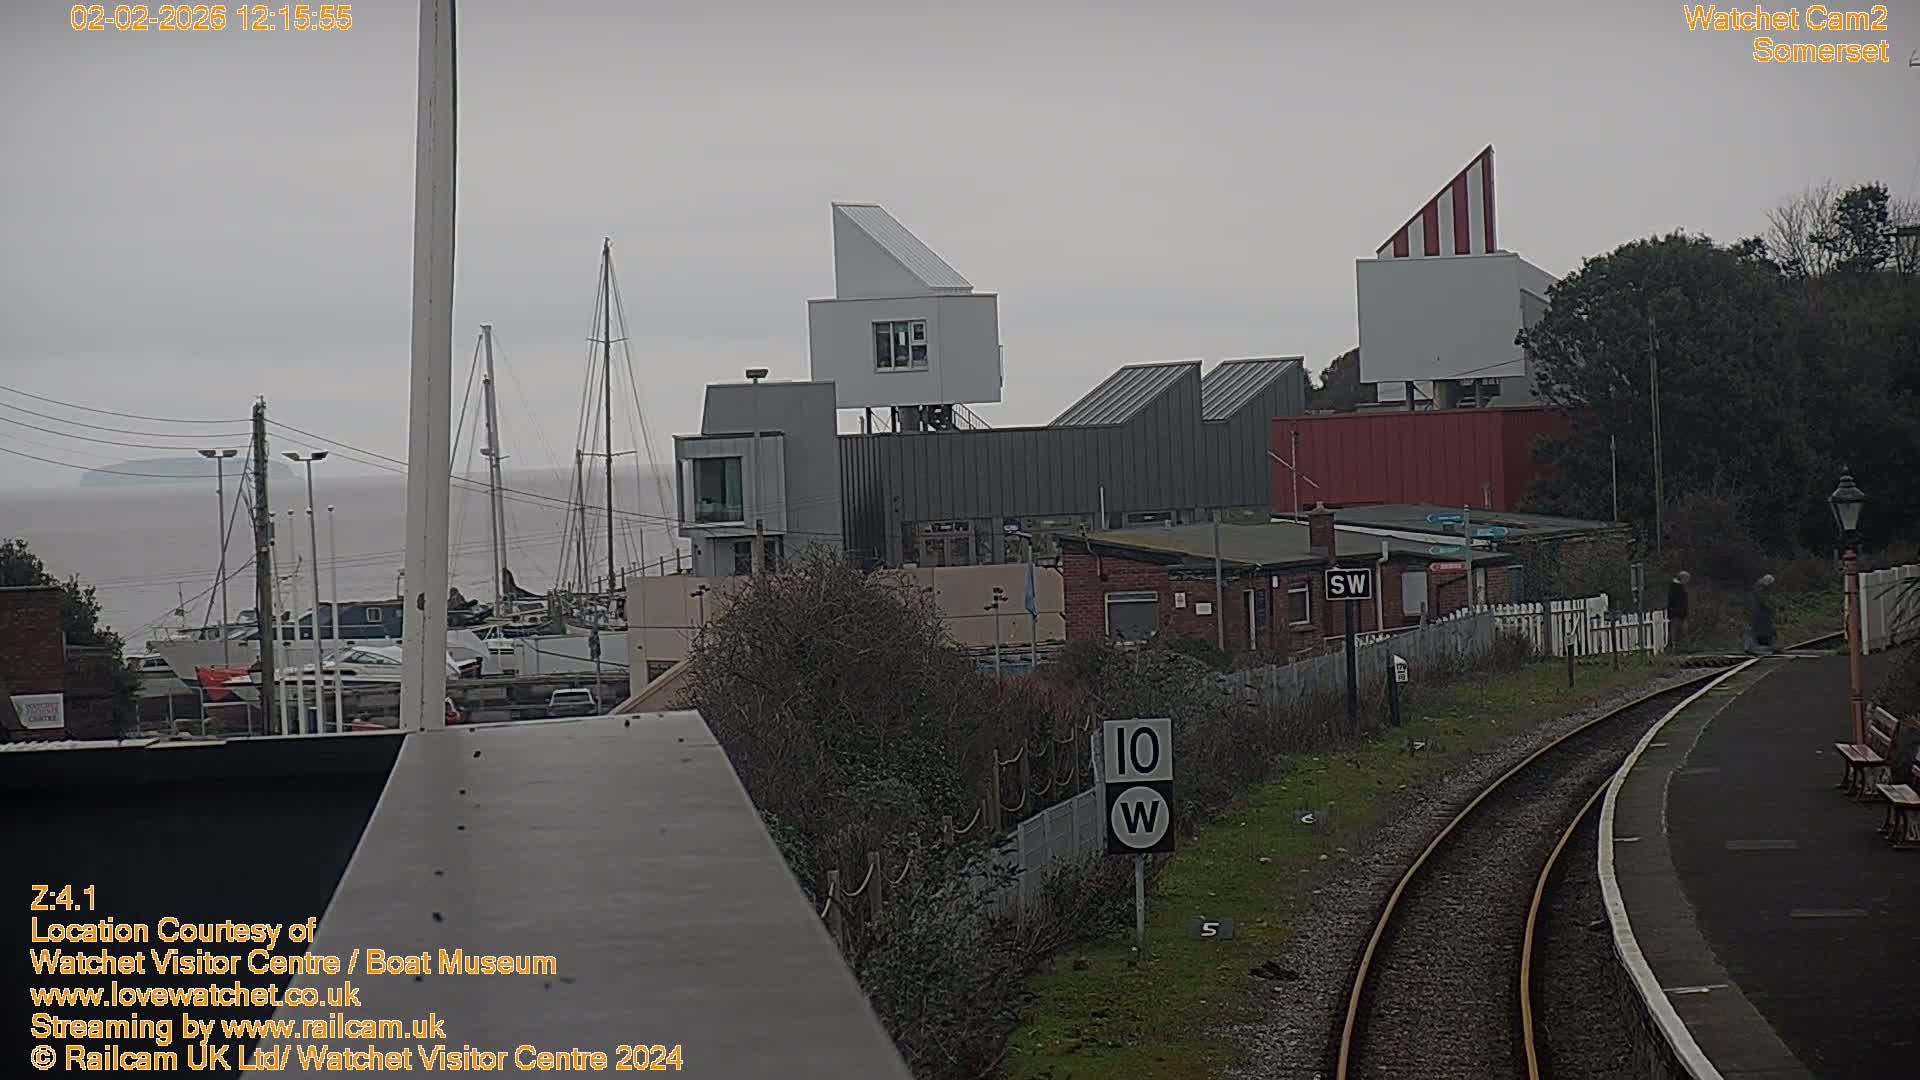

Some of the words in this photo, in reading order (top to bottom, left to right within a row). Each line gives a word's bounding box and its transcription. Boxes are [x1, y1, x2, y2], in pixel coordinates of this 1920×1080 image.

[1330, 574, 1366, 595] SW
[1116, 726, 1160, 775] 10
[1119, 800, 1160, 834] W
[1200, 922, 1220, 937] 5
